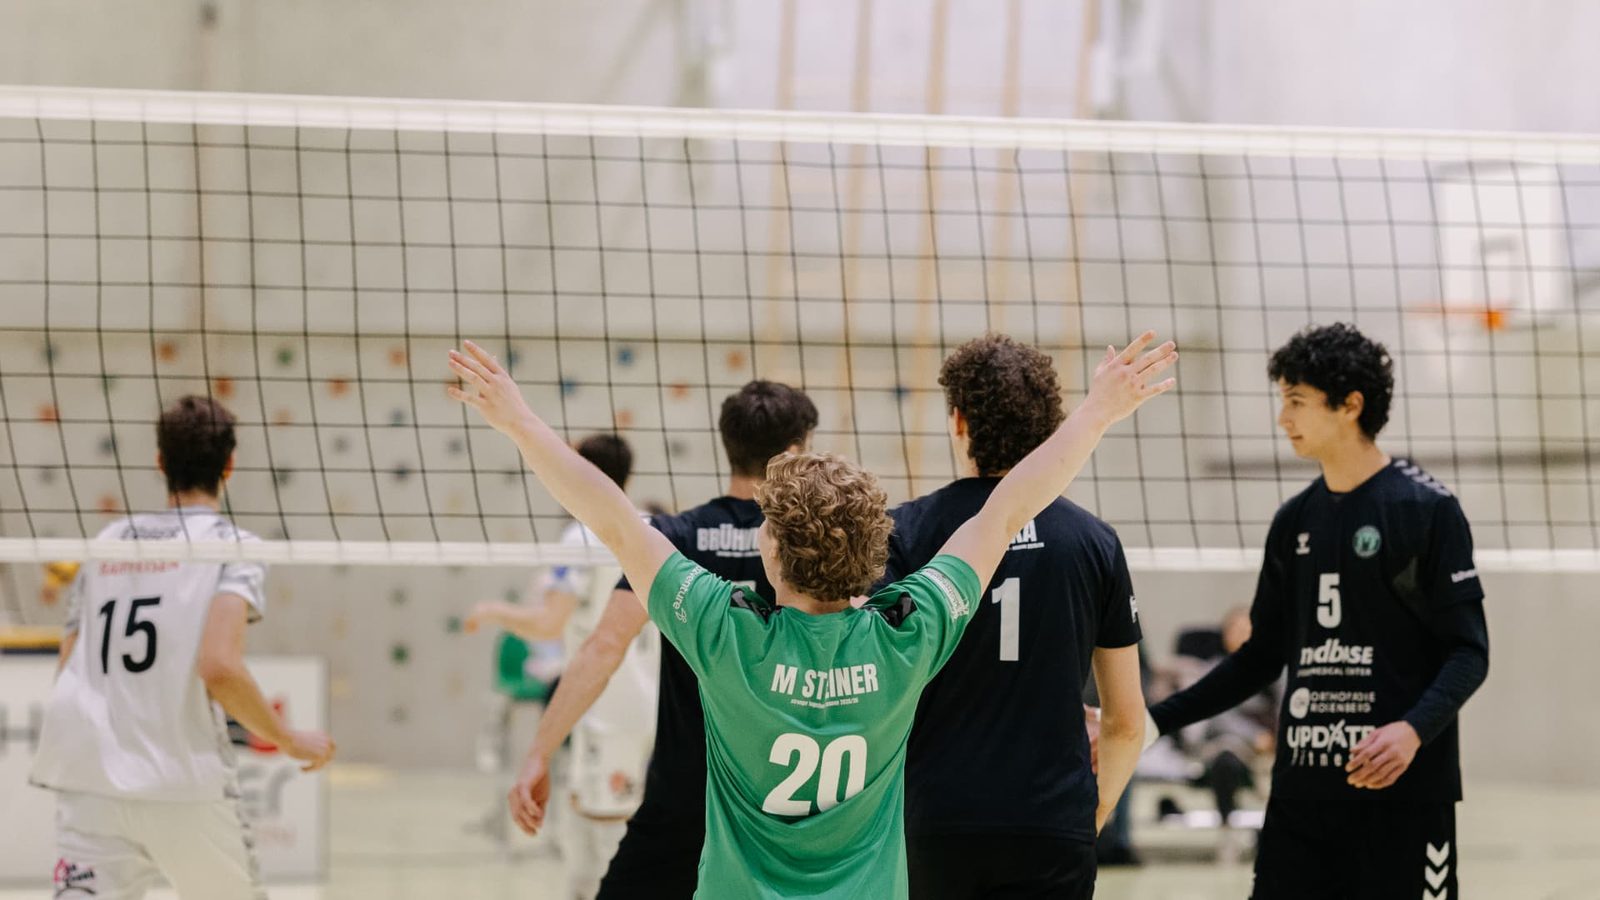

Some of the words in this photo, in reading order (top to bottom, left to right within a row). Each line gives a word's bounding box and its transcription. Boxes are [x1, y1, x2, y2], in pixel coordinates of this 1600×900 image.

[99, 597, 161, 675] 15
[992, 577, 1021, 661] 1
[1317, 573, 1342, 628] 5
[770, 663, 798, 695] M
[801, 663, 879, 700] STINER
[762, 733, 868, 817] 20
